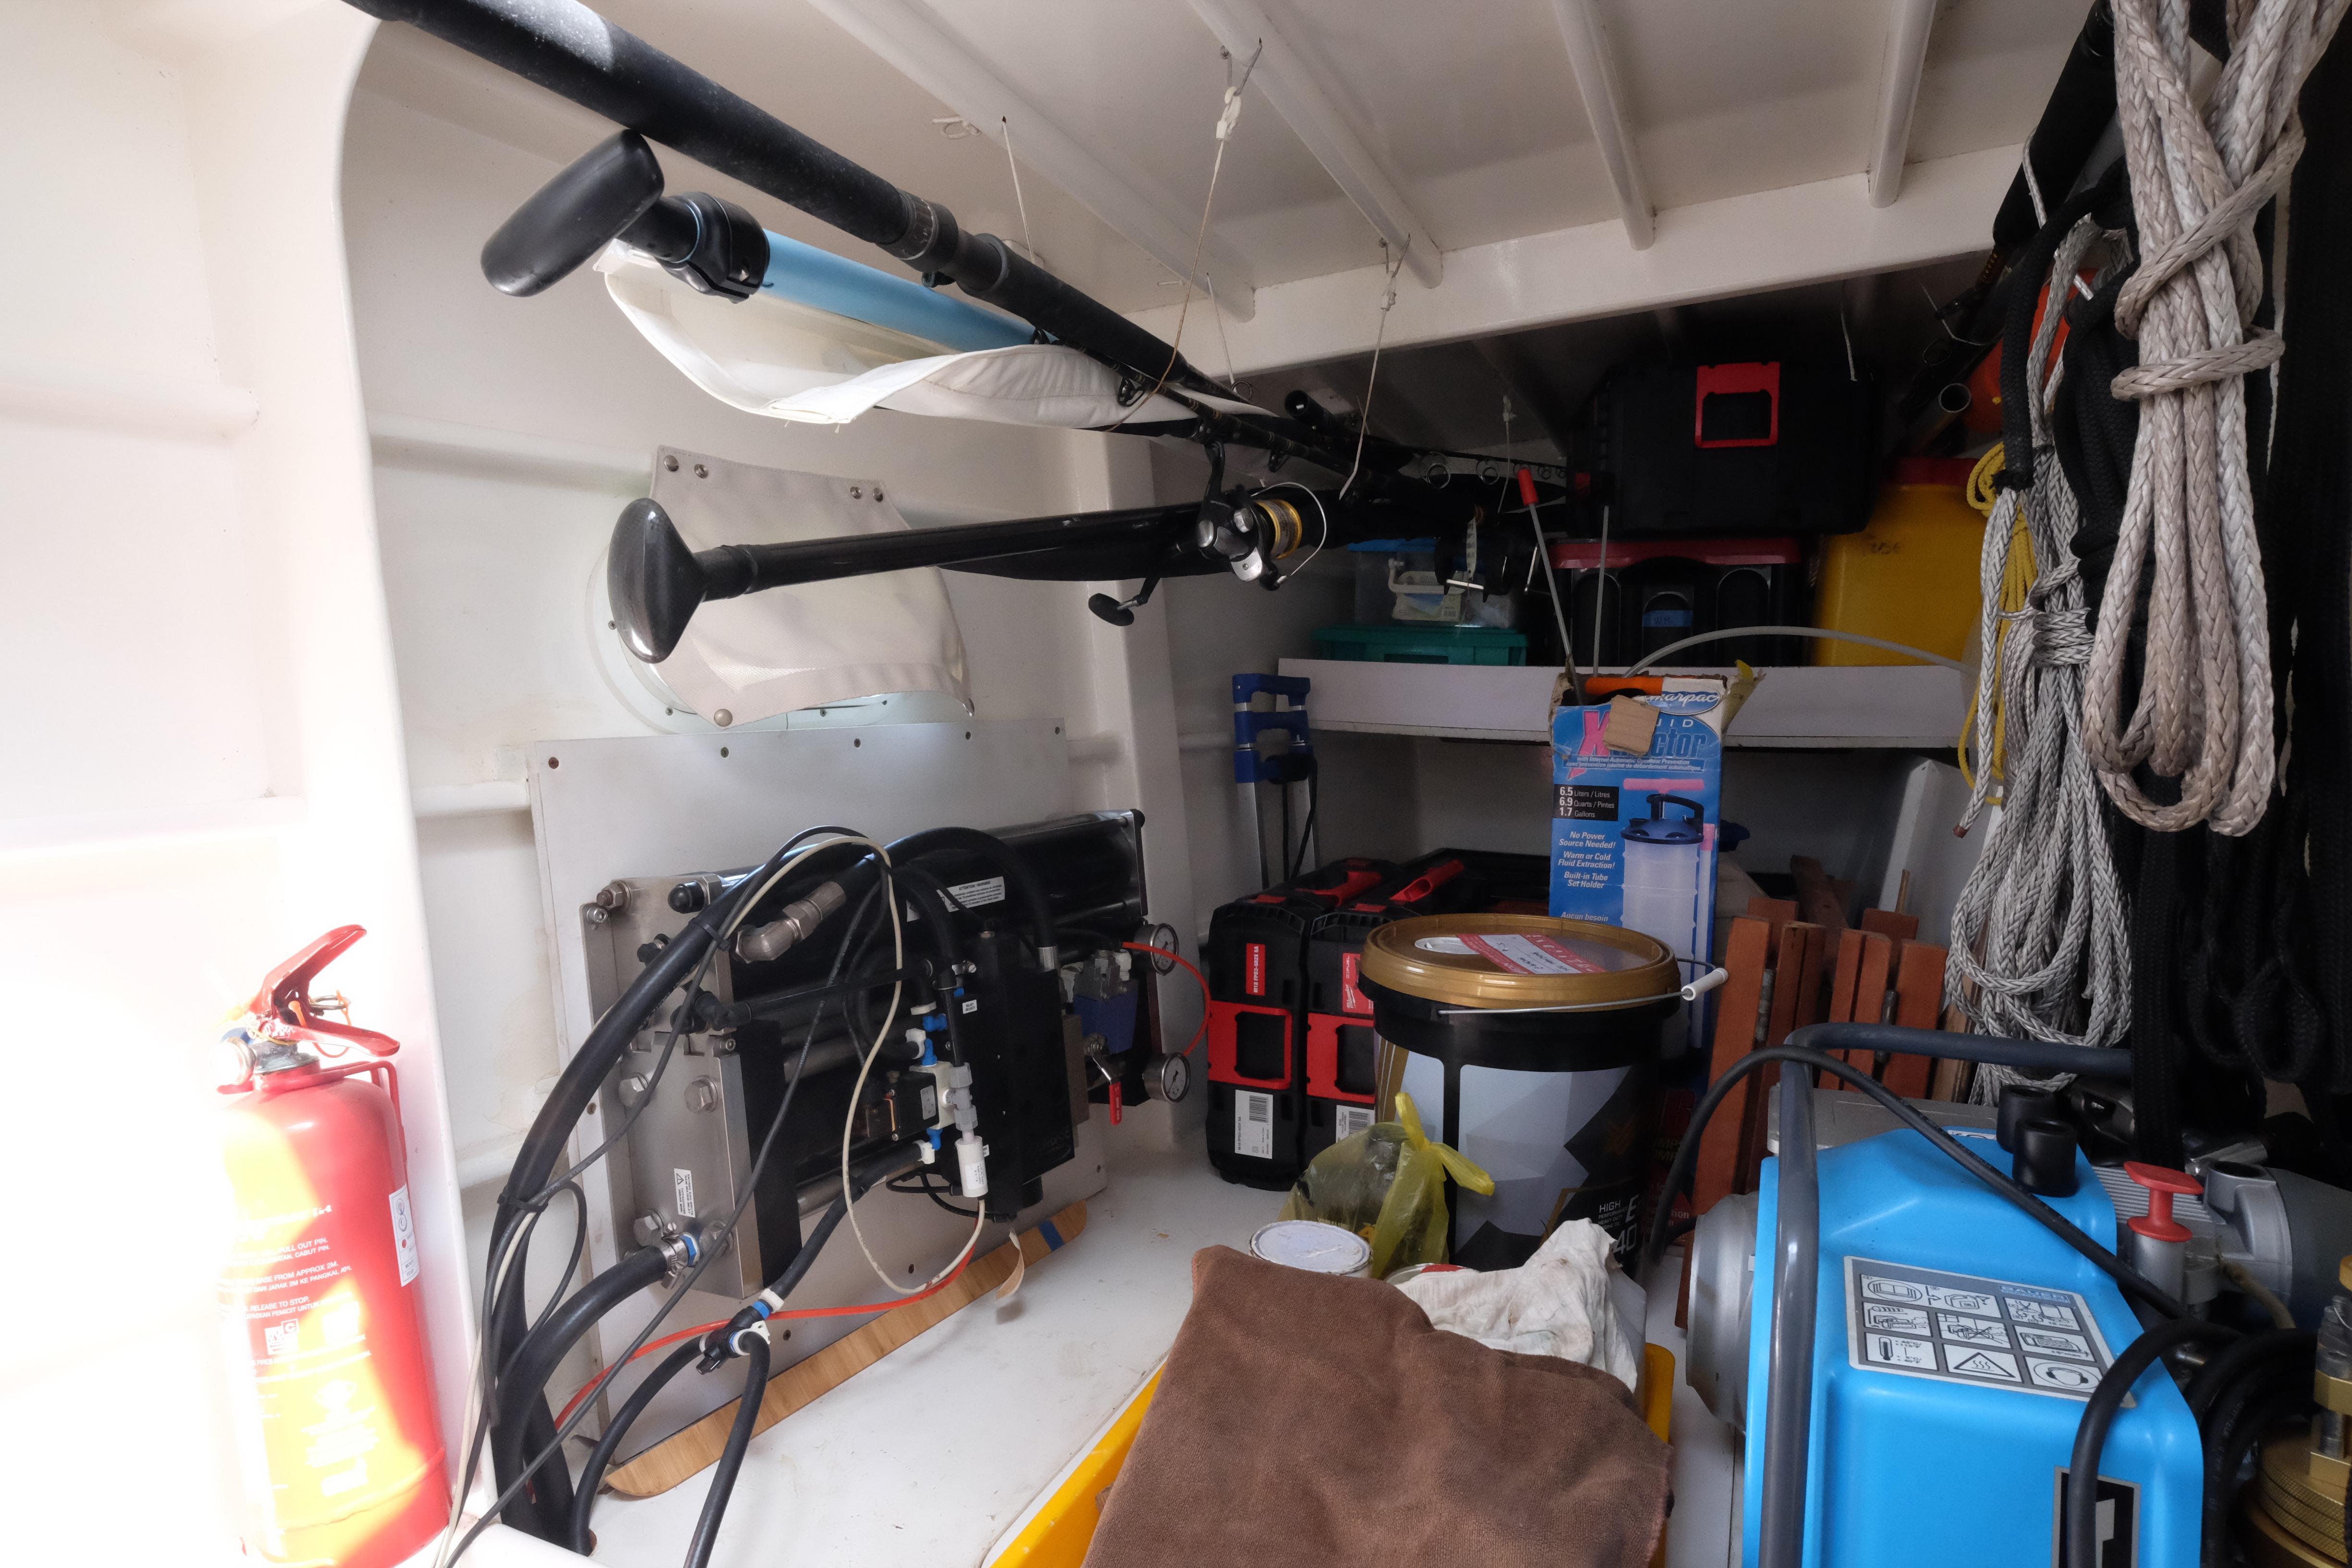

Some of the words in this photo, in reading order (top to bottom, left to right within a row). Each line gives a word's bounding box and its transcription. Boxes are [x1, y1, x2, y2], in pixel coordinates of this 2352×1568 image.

[1647, 693, 1719, 708] marpac
[1559, 786, 1574, 797] 6.5
[1559, 796, 1573, 807] 6.9
[1597, 801, 1615, 809] Pintes
[1559, 807, 1572, 817] 1.7
[1581, 832, 1605, 840] Power
[1558, 838, 1584, 847] Source
[1585, 840, 1616, 849] Needed!
[1563, 851, 1584, 859] Warm
[1594, 853, 1611, 861] Cold
[1557, 859, 1576, 868] Fluid
[1577, 861, 1616, 870] Extraction!
[1564, 871, 1590, 881] Built-in
[1592, 873, 1609, 881] Tube
[1561, 911, 1584, 920] Aucun
[1585, 913, 1609, 922] besoin
[1599, 1200, 1621, 1213] HIGH
[297, 1240, 313, 1249] OUT
[314, 1237, 329, 1246] PIN.
[295, 1249, 317, 1258] CABUT
[274, 1272, 294, 1281] FROM
[296, 1264, 325, 1277] APPROX
[326, 1260, 340, 1269] 2M.
[268, 1282, 288, 1292] JARAK
[309, 1269, 339, 1283] PANGKAL
[340, 1264, 353, 1273] API.
[2000, 1286, 2068, 1300] BAUER
[250, 1302, 277, 1312] RELEASE
[289, 1296, 310, 1306] STOP.
[284, 1323, 297, 1333] C
